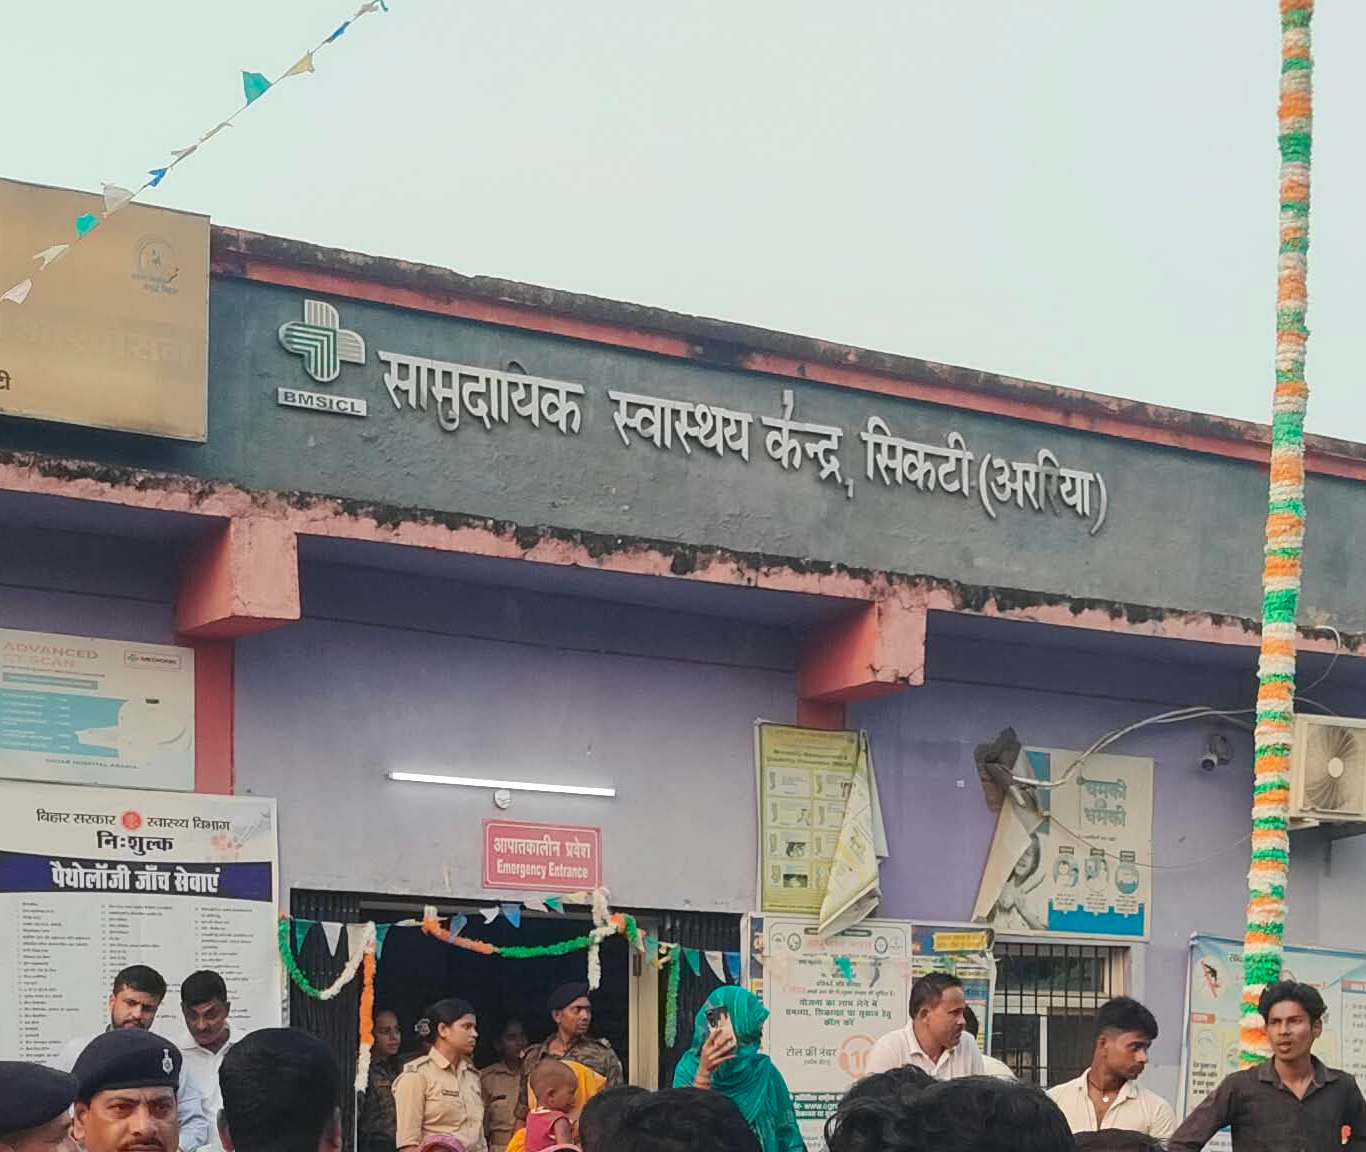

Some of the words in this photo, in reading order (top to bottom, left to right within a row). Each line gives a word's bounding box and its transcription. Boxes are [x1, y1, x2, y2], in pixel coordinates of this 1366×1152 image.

[284, 391, 362, 414] BMSICL
[377, 350, 585, 435] सामुदायिक
[860, 415, 975, 497] सिकटी
[3, 641, 98, 660] ADVANCED
[73, 813, 116, 826] सरकार
[192, 817, 231, 832] विभाग
[493, 834, 561, 857] आपातकालीन
[565, 836, 592, 859] प्रवेश
[49, 861, 132, 890] पैथोलॉजी
[173, 866, 221, 893] सेवाएं
[496, 859, 547, 880] Emergency
[548, 862, 589, 879] Entrance
